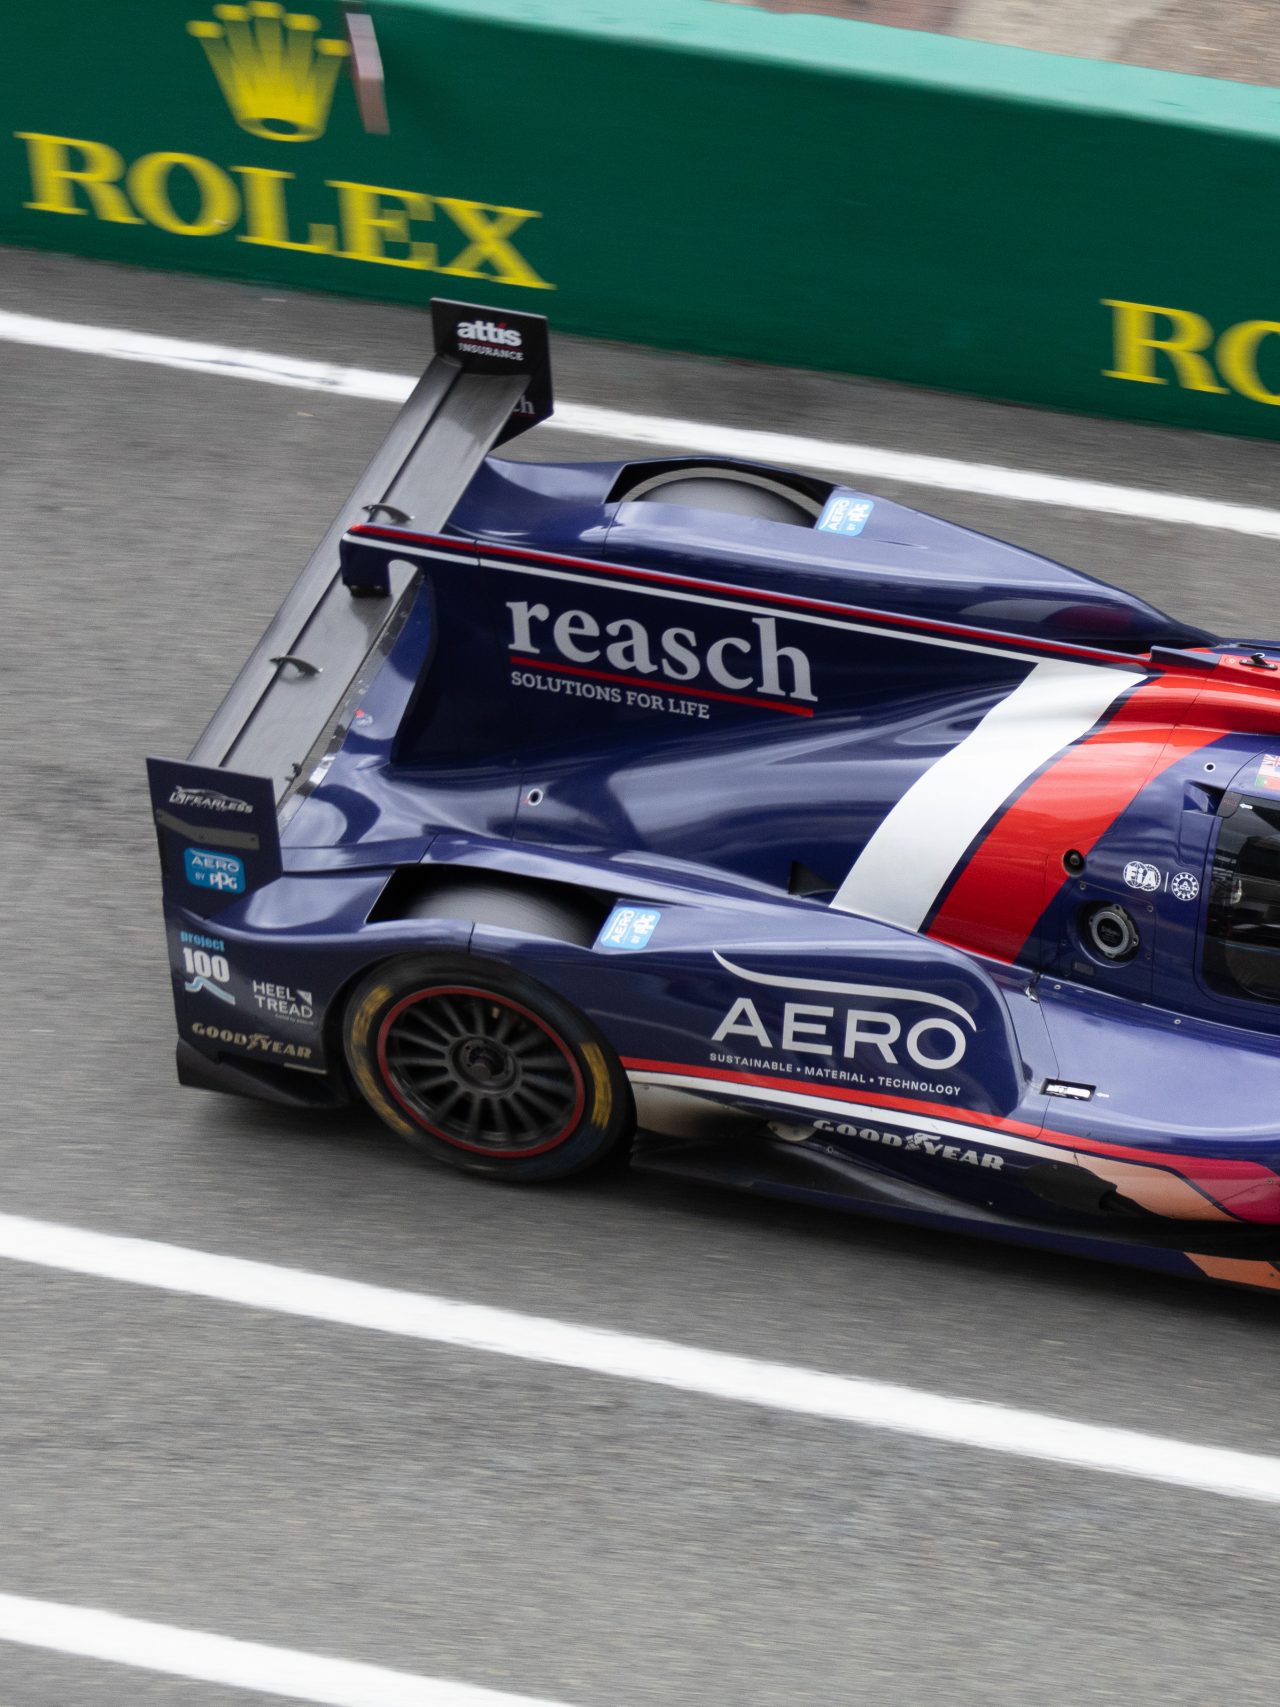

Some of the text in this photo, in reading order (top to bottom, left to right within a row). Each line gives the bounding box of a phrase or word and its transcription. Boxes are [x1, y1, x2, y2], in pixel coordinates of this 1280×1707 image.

[14, 132, 556, 290] ROLEX
[457, 321, 522, 347] attis
[458, 343, 524, 361] INSURANCE
[506, 601, 818, 701] reasch
[511, 671, 710, 719] SOLUTIONS FOR LIFE
[192, 856, 239, 873] AERO
[195, 872, 205, 881] BY
[180, 930, 225, 952] project
[611, 909, 635, 944] AERO
[183, 947, 230, 983] 100
[252, 979, 296, 1000] HEEL
[254, 995, 313, 1019] TREAD
[191, 1021, 312, 1060] GOODYEAR
[711, 997, 967, 1070] AERO
[709, 1052, 961, 1096] SUSTAINABLE MATERIAL TECHNOLOGY
[812, 1119, 1005, 1171] GOODYEAR
